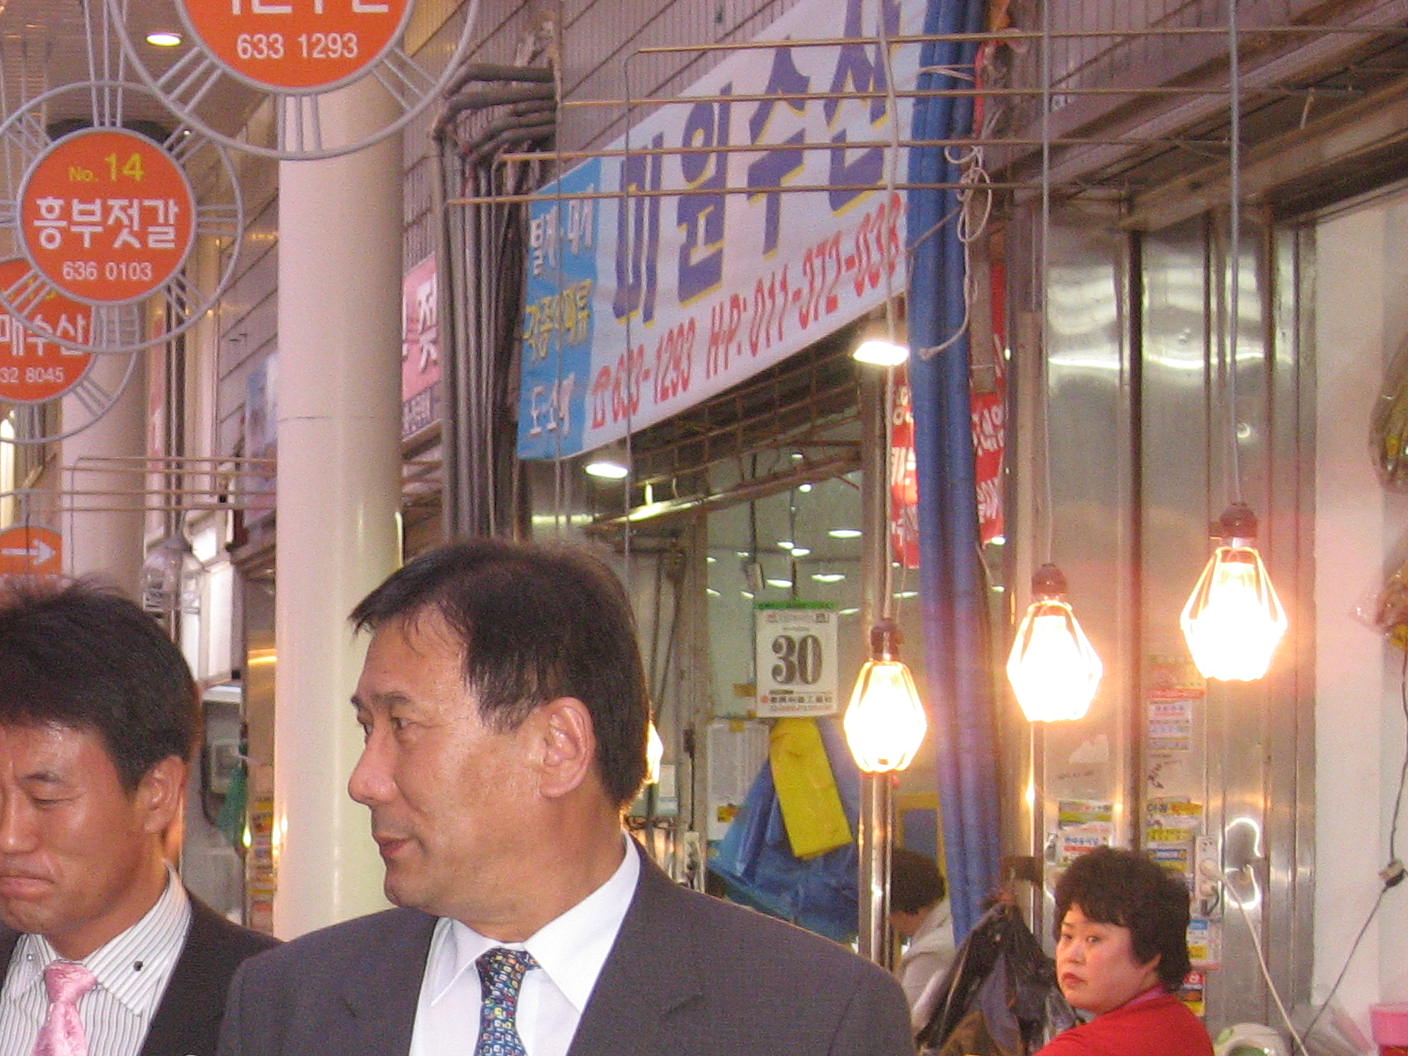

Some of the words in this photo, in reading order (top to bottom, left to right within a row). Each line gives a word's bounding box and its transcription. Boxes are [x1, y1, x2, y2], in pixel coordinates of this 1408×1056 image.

[236, 33, 285, 59] 633
[297, 33, 359, 58] 1293
[68, 166, 98, 182] No.
[105, 152, 145, 182] 14
[33, 196, 180, 250] 흥부젓갈
[63, 261, 98, 281] 636
[105, 262, 153, 281] 0103
[772, 634, 823, 685] 30
